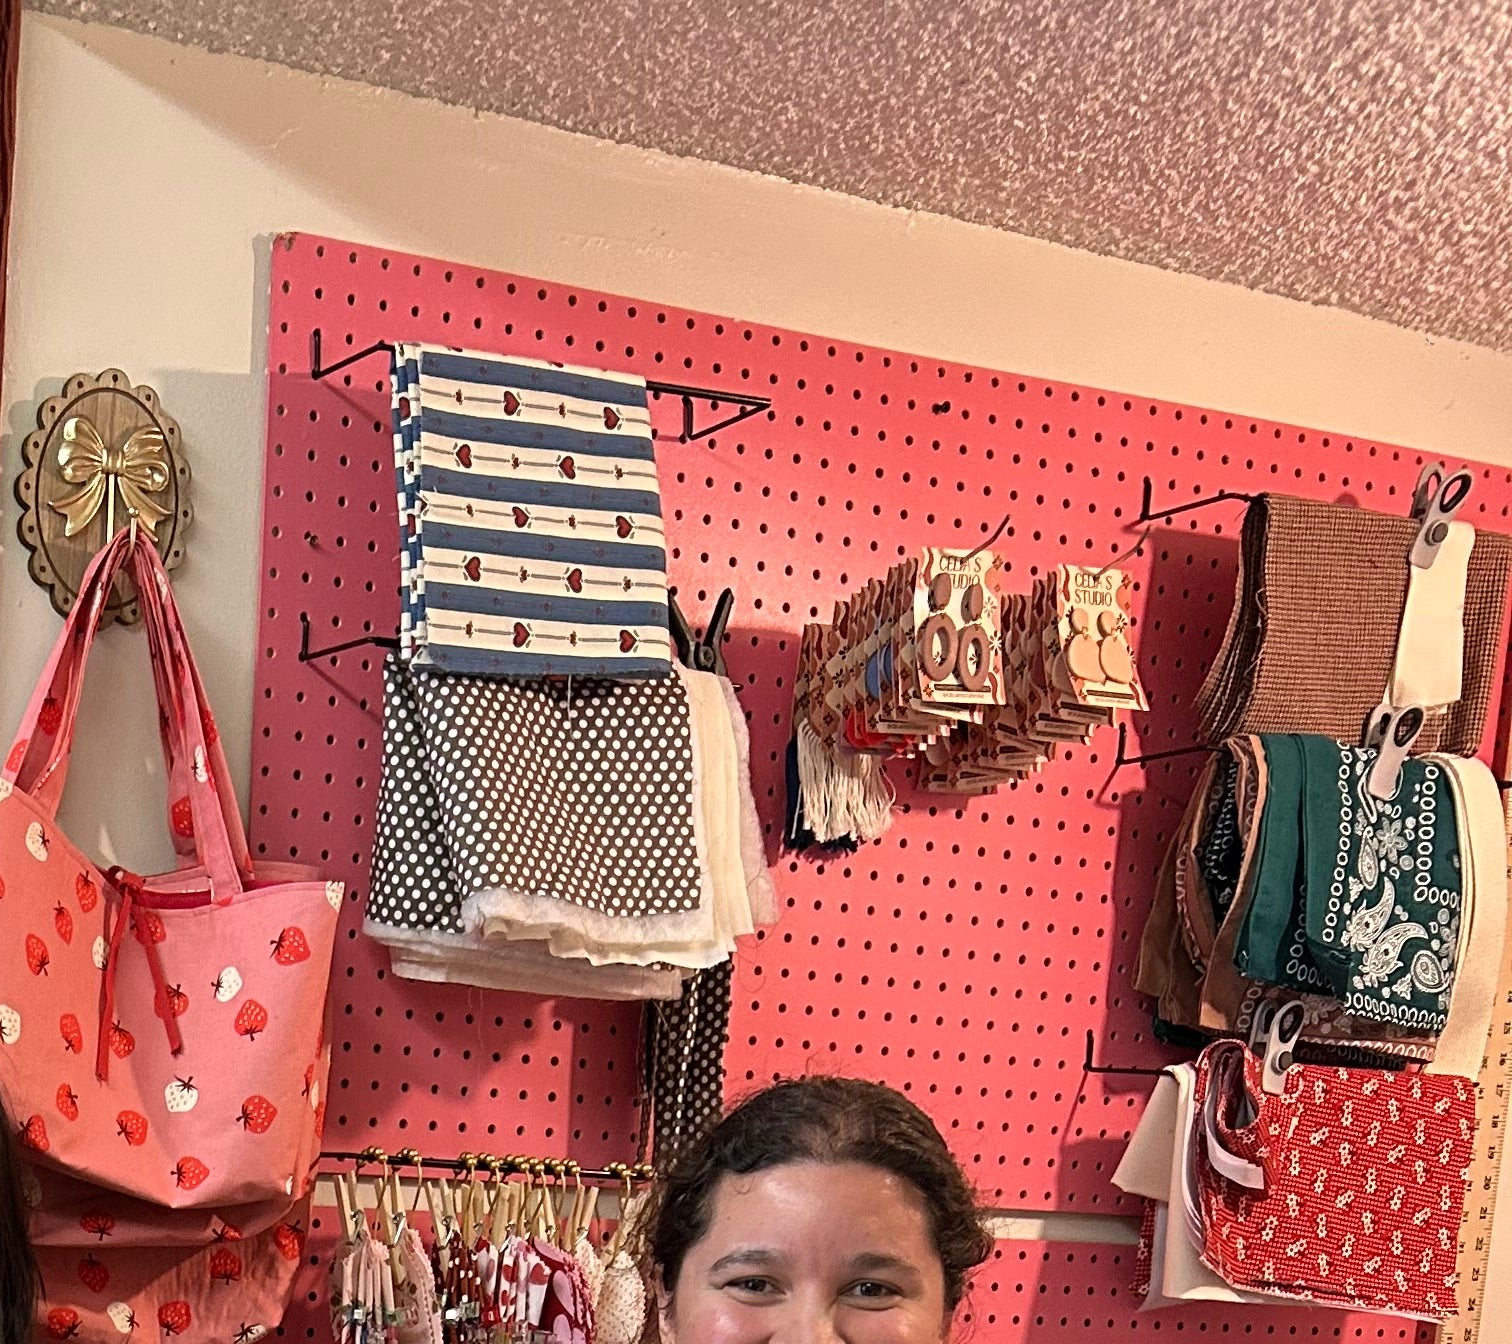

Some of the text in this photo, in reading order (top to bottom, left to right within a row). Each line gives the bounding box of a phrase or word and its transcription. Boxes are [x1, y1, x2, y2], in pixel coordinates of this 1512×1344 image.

[1075, 589, 1112, 606] STUDIO
[1499, 1053, 1507, 1066] 16
[1496, 1084, 1503, 1097] 17
[1492, 1115, 1499, 1128] 18
[1488, 1146, 1495, 1159] 19
[1483, 1176, 1491, 1190] 20
[1480, 1207, 1487, 1220] 21
[1475, 1237, 1483, 1251] 22
[1472, 1268, 1479, 1281] 23
[1468, 1298, 1475, 1311] 24
[1464, 1328, 1472, 1342] 25
